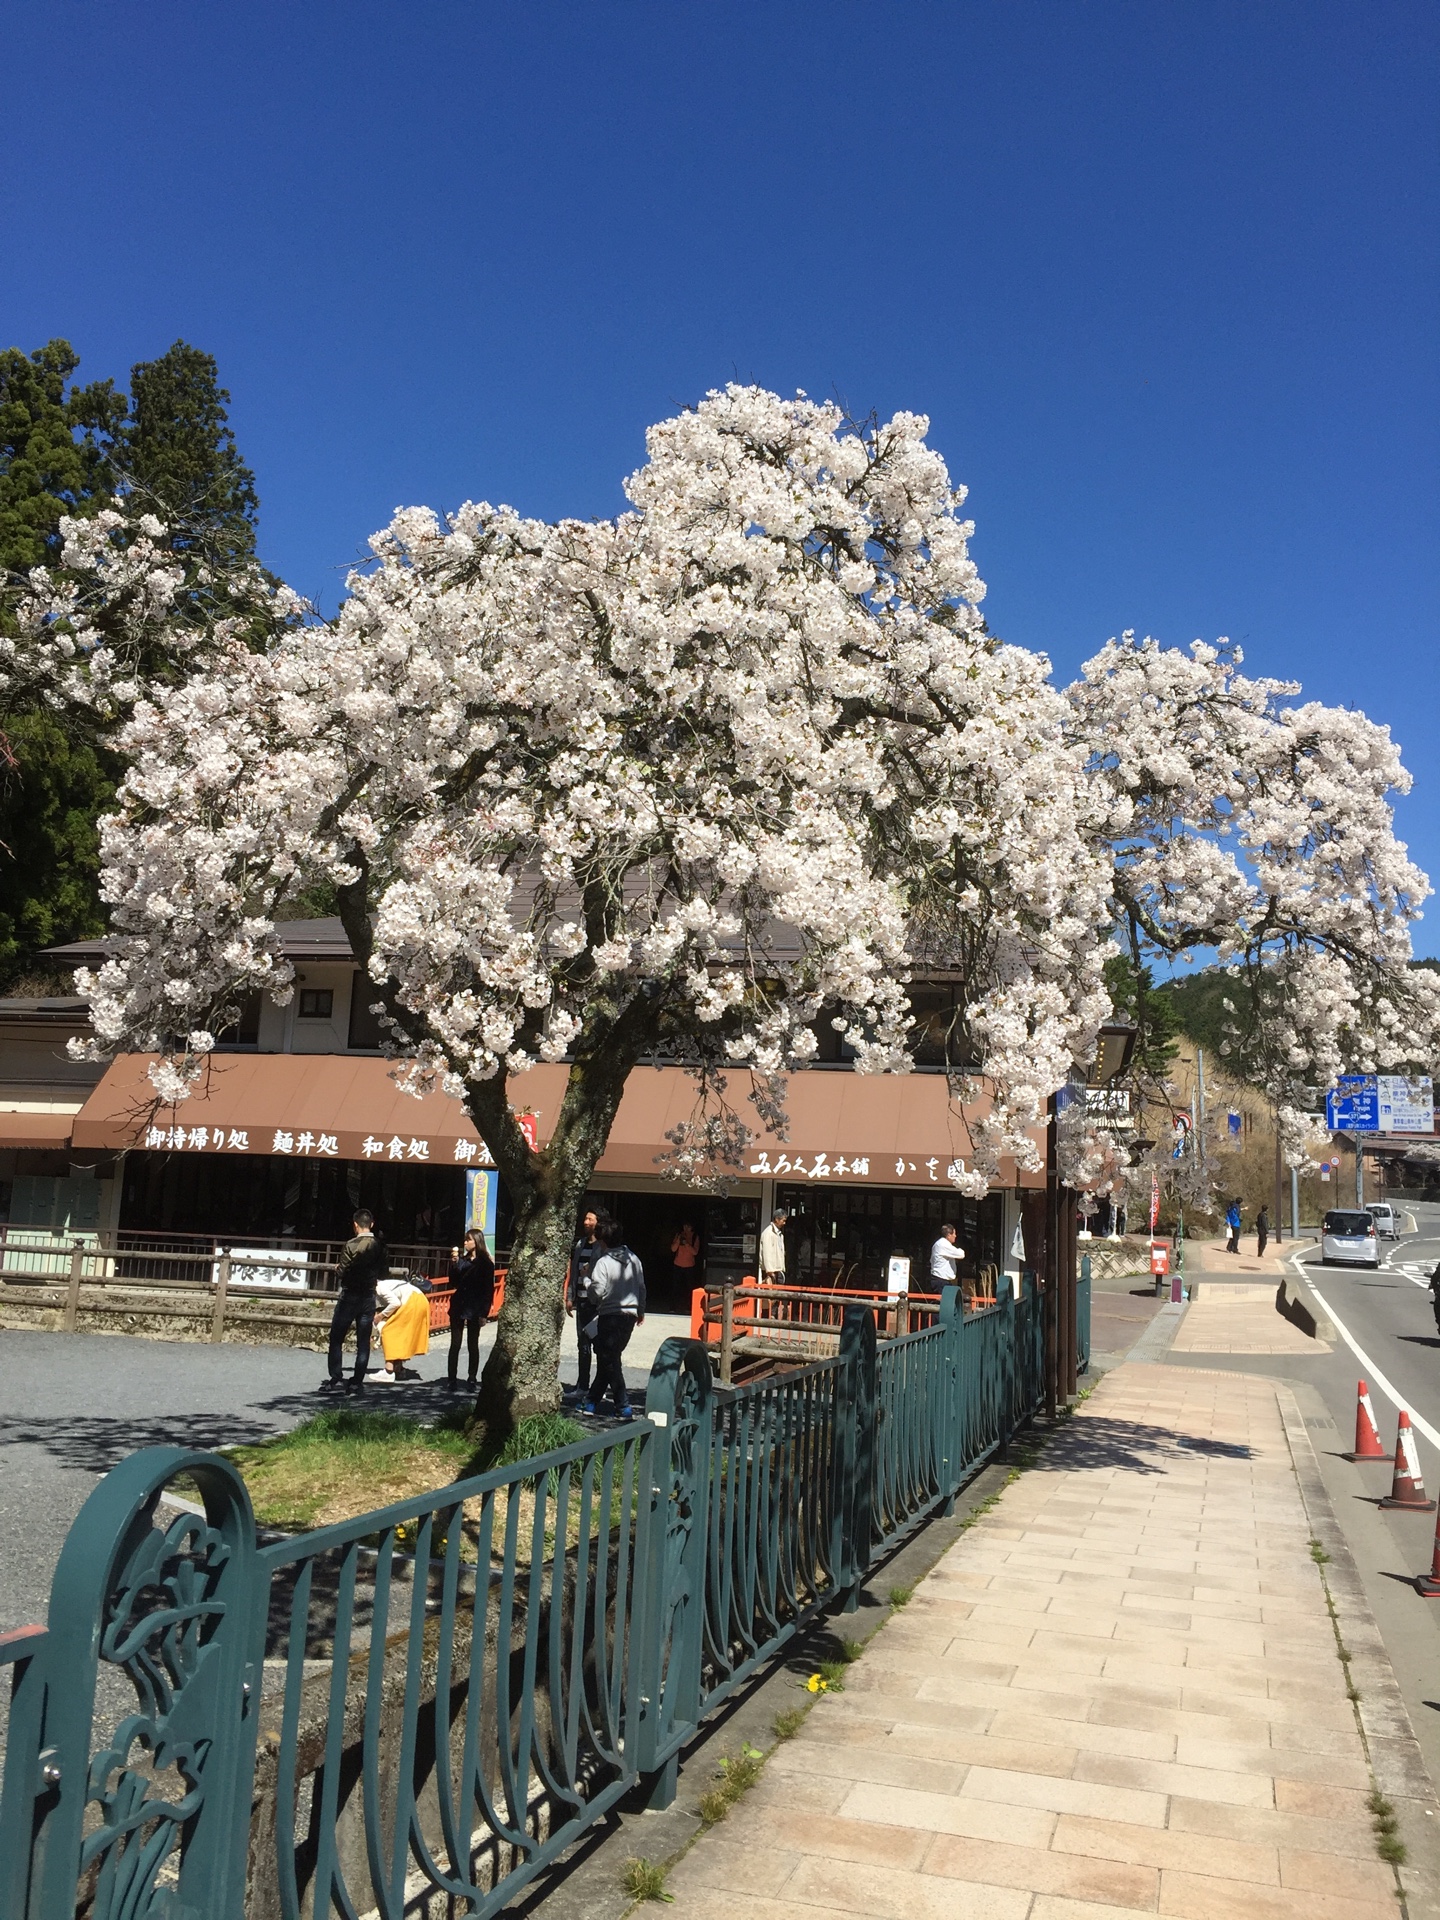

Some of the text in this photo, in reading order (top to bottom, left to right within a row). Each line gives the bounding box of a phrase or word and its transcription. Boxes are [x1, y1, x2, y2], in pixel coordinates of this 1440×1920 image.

[145, 1126, 249, 1151] 御持帰り処
[271, 1129, 339, 1155] 麺丼処
[361, 1135, 430, 1160] 和食処
[750, 1152, 870, 1179] みろく石本舗
[475, 1175, 486, 1228] ソフトクリーム
